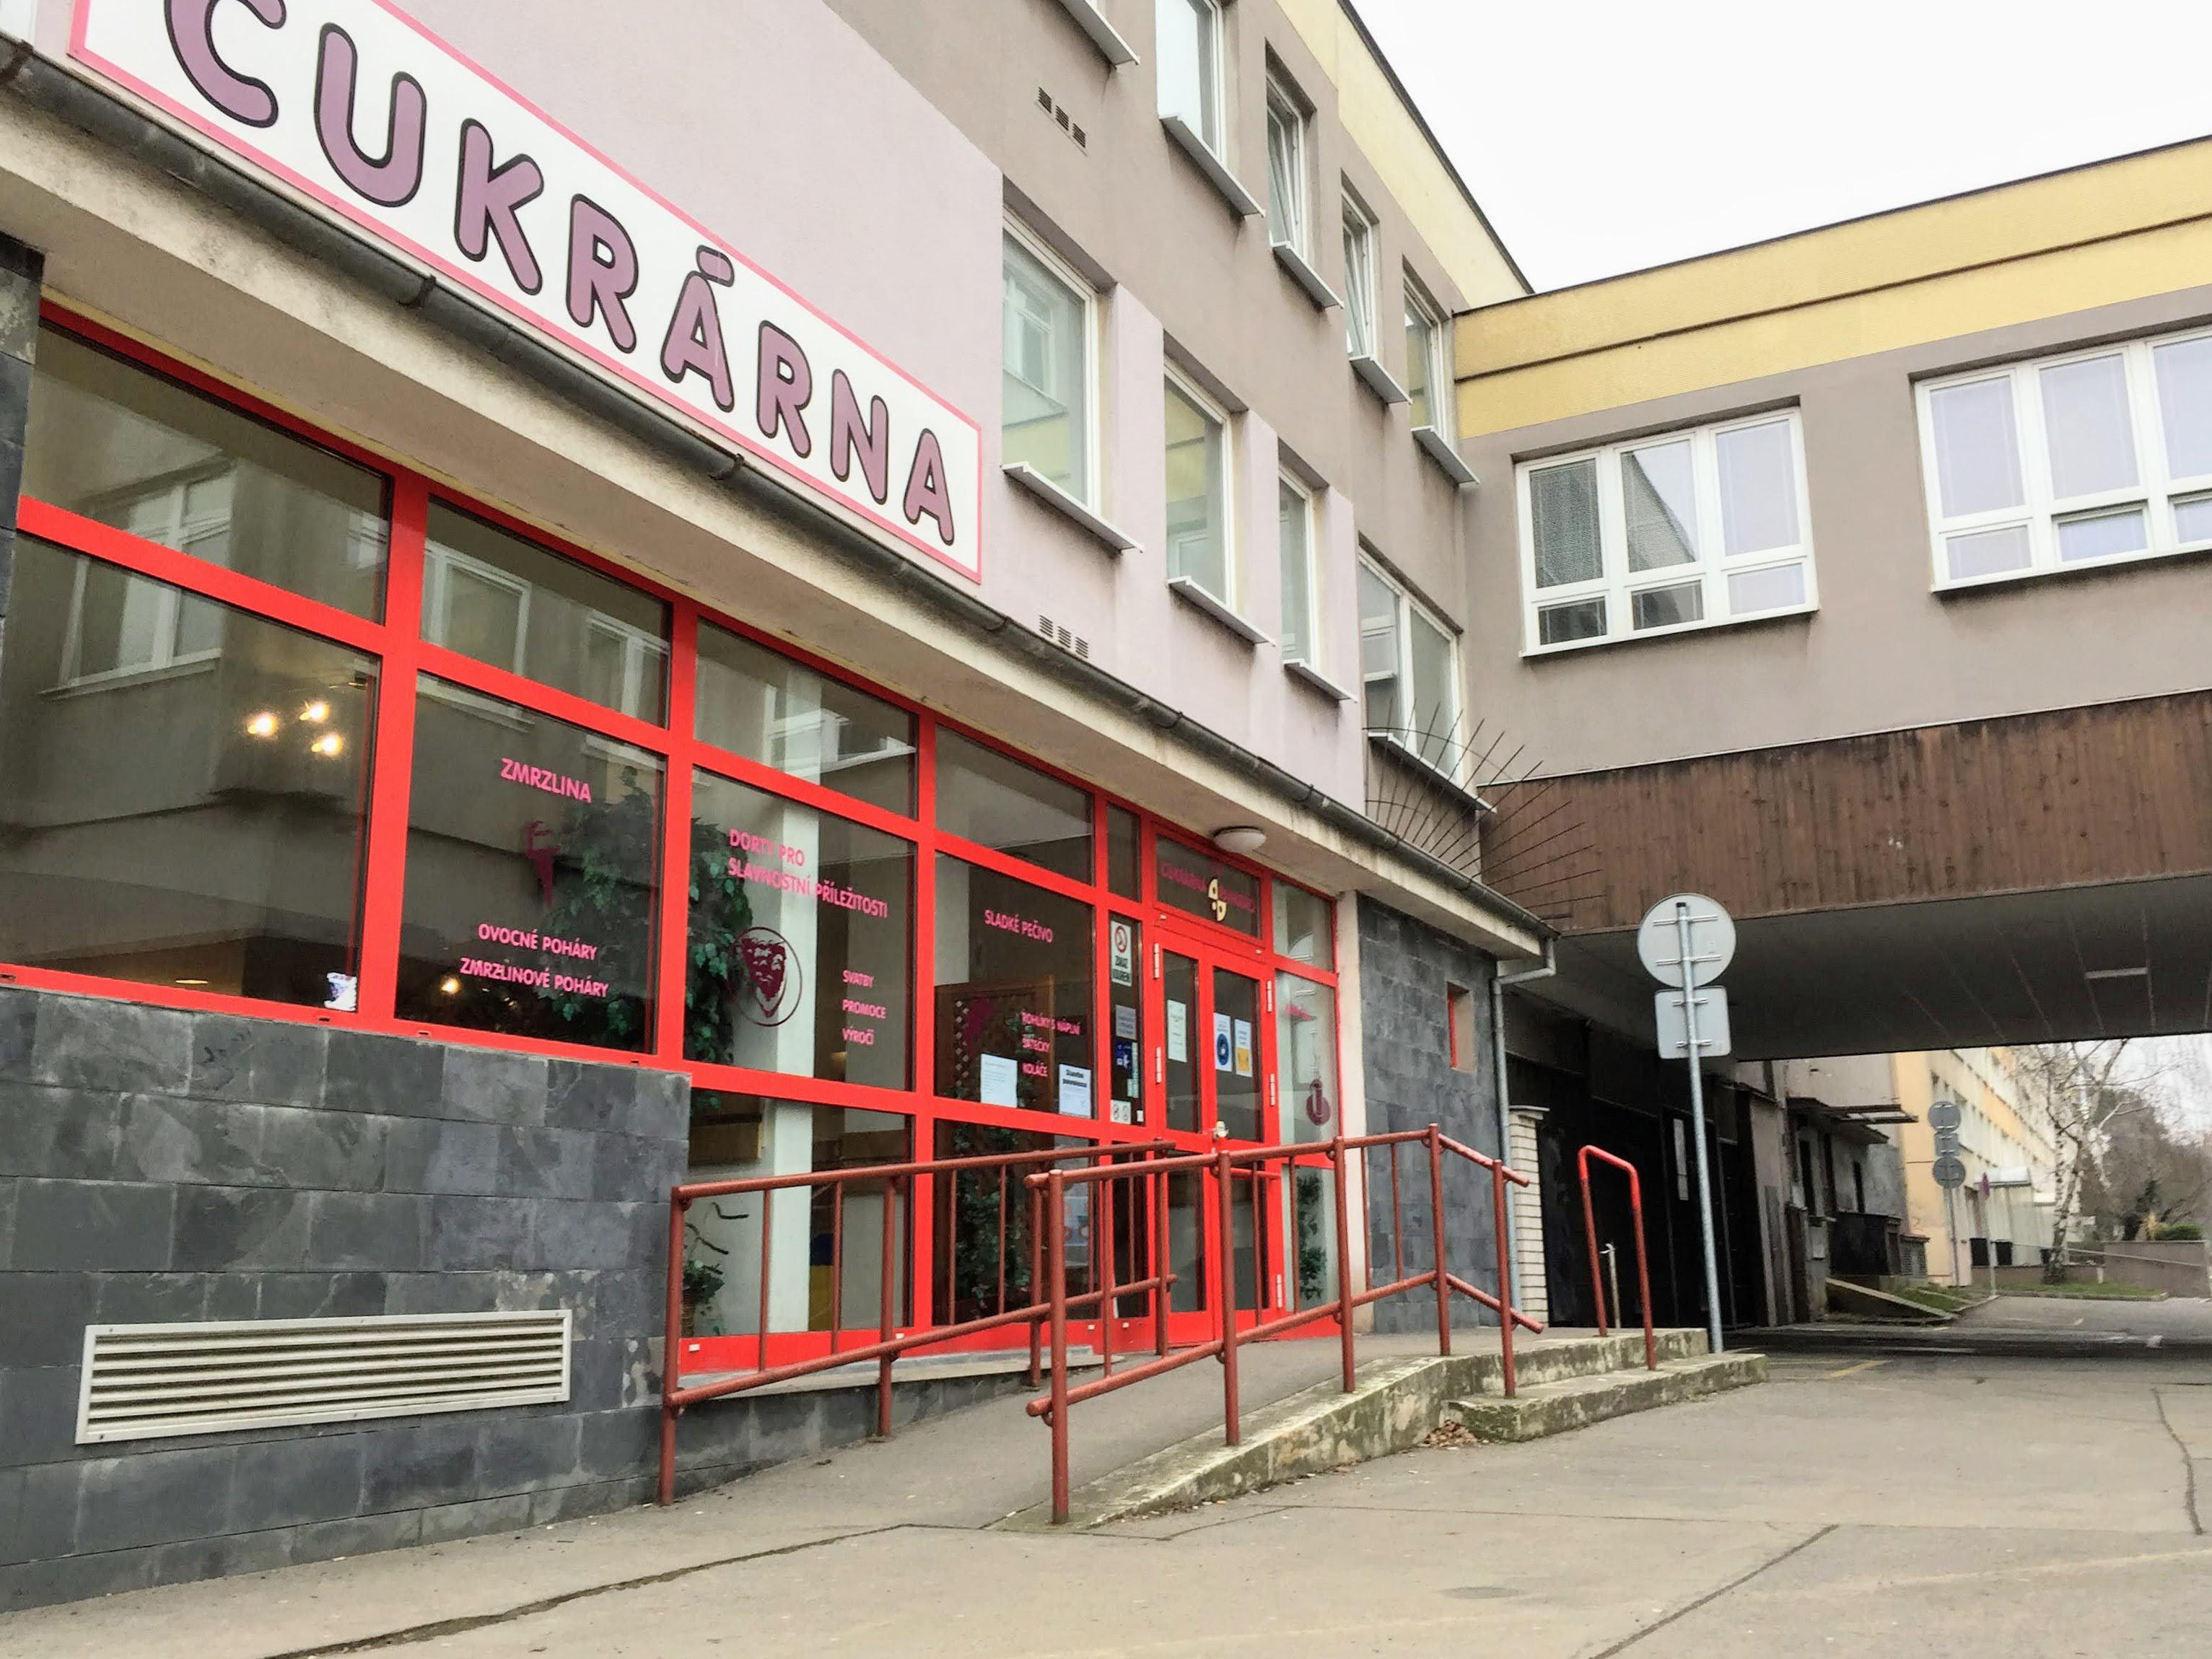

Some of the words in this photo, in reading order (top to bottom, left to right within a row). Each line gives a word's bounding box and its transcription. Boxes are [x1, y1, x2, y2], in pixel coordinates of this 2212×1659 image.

[161, 0, 956, 546] CUKRÁRNA
[501, 757, 592, 803] ZMRZLINA
[728, 828, 774, 857] DORTY
[779, 844, 805, 867] PRO
[728, 857, 811, 896] SLAVNOSTNÍ
[815, 879, 888, 919] PŘÍLEŽITOSTI
[478, 923, 538, 950] OVOCNÉ
[542, 937, 598, 960] POHÁRY
[984, 909, 1020, 934] SLADKÉ
[1021, 919, 1054, 943] PEČIVO
[460, 957, 551, 988] ZMRZLINOVÉ
[554, 975, 609, 998] POHÁRY
[842, 999, 887, 1020] PROMOCE
